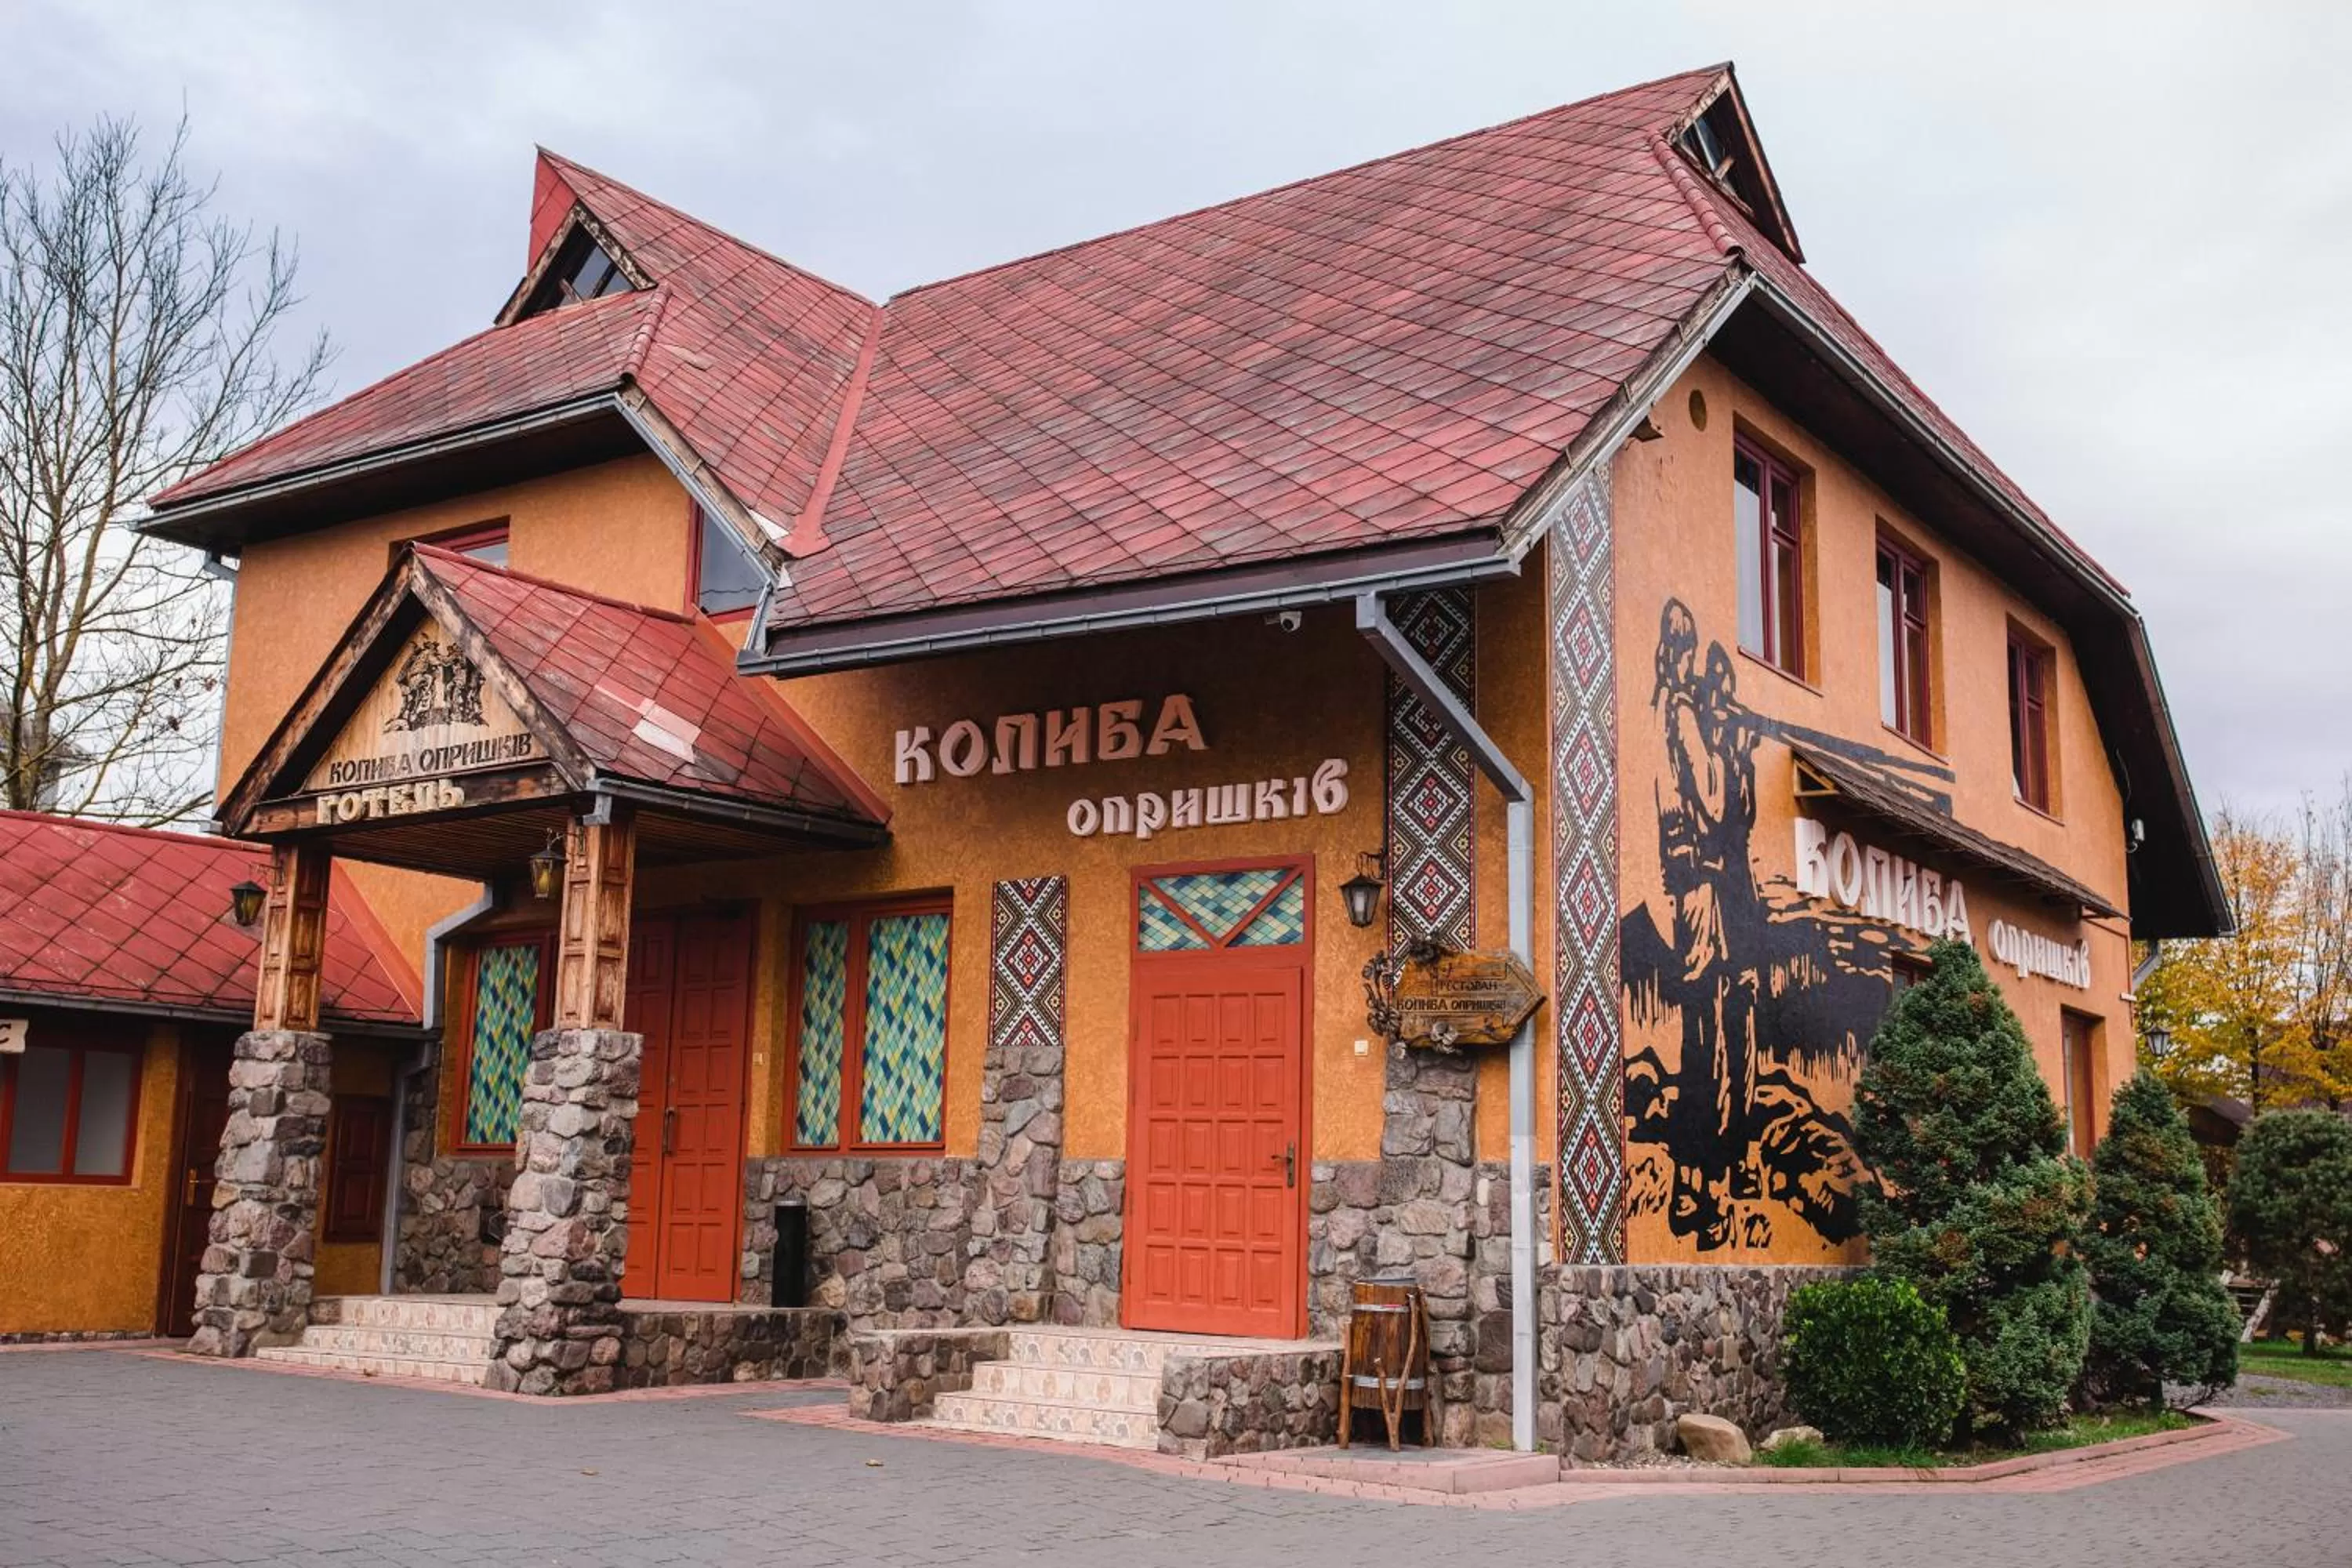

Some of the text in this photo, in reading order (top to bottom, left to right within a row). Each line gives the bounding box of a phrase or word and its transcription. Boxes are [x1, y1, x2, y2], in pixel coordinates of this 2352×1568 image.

[419, 733, 532, 772] ОПРИШКІВ
[895, 693, 1210, 783] КОЛИБА
[317, 779, 465, 824] ГОТЕЛЬ
[1795, 817, 1973, 946] КОЛИБА
[1396, 999, 1448, 1011] КОЛИБА
